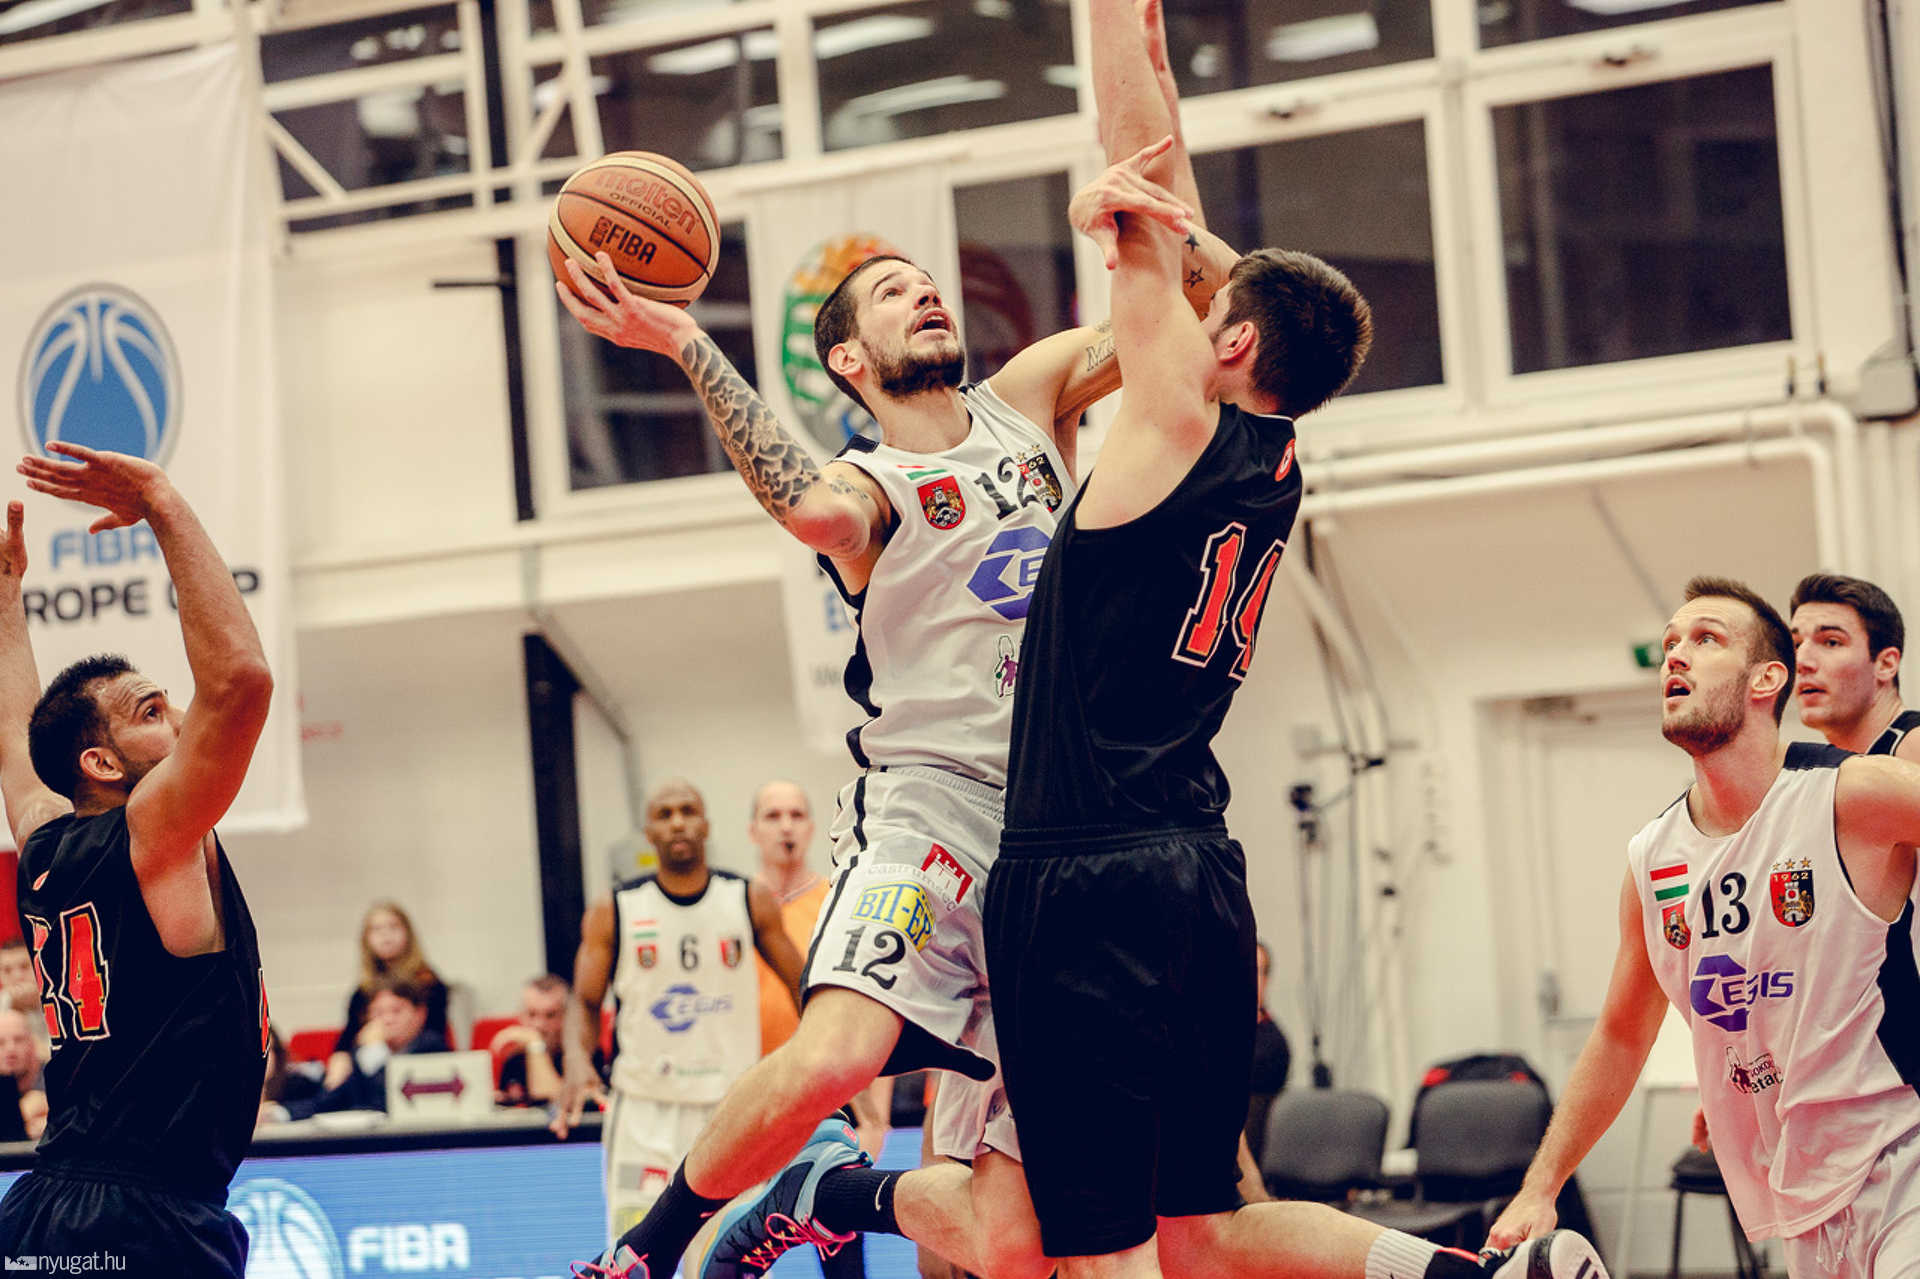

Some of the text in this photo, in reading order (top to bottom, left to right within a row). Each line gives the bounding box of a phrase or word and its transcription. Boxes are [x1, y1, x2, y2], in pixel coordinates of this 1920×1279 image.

[597, 172, 700, 235] molten
[609, 192, 672, 229] OFFICIAL
[605, 224, 657, 265] FIBA
[973, 456, 1041, 521] 12
[52, 525, 158, 570] FIBA
[1171, 521, 1286, 682] 14
[1774, 871, 1809, 882] 1962
[1702, 871, 1751, 939] 13
[680, 933, 699, 971] 6
[832, 925, 907, 990] 12
[349, 1223, 471, 1273] FIBA
